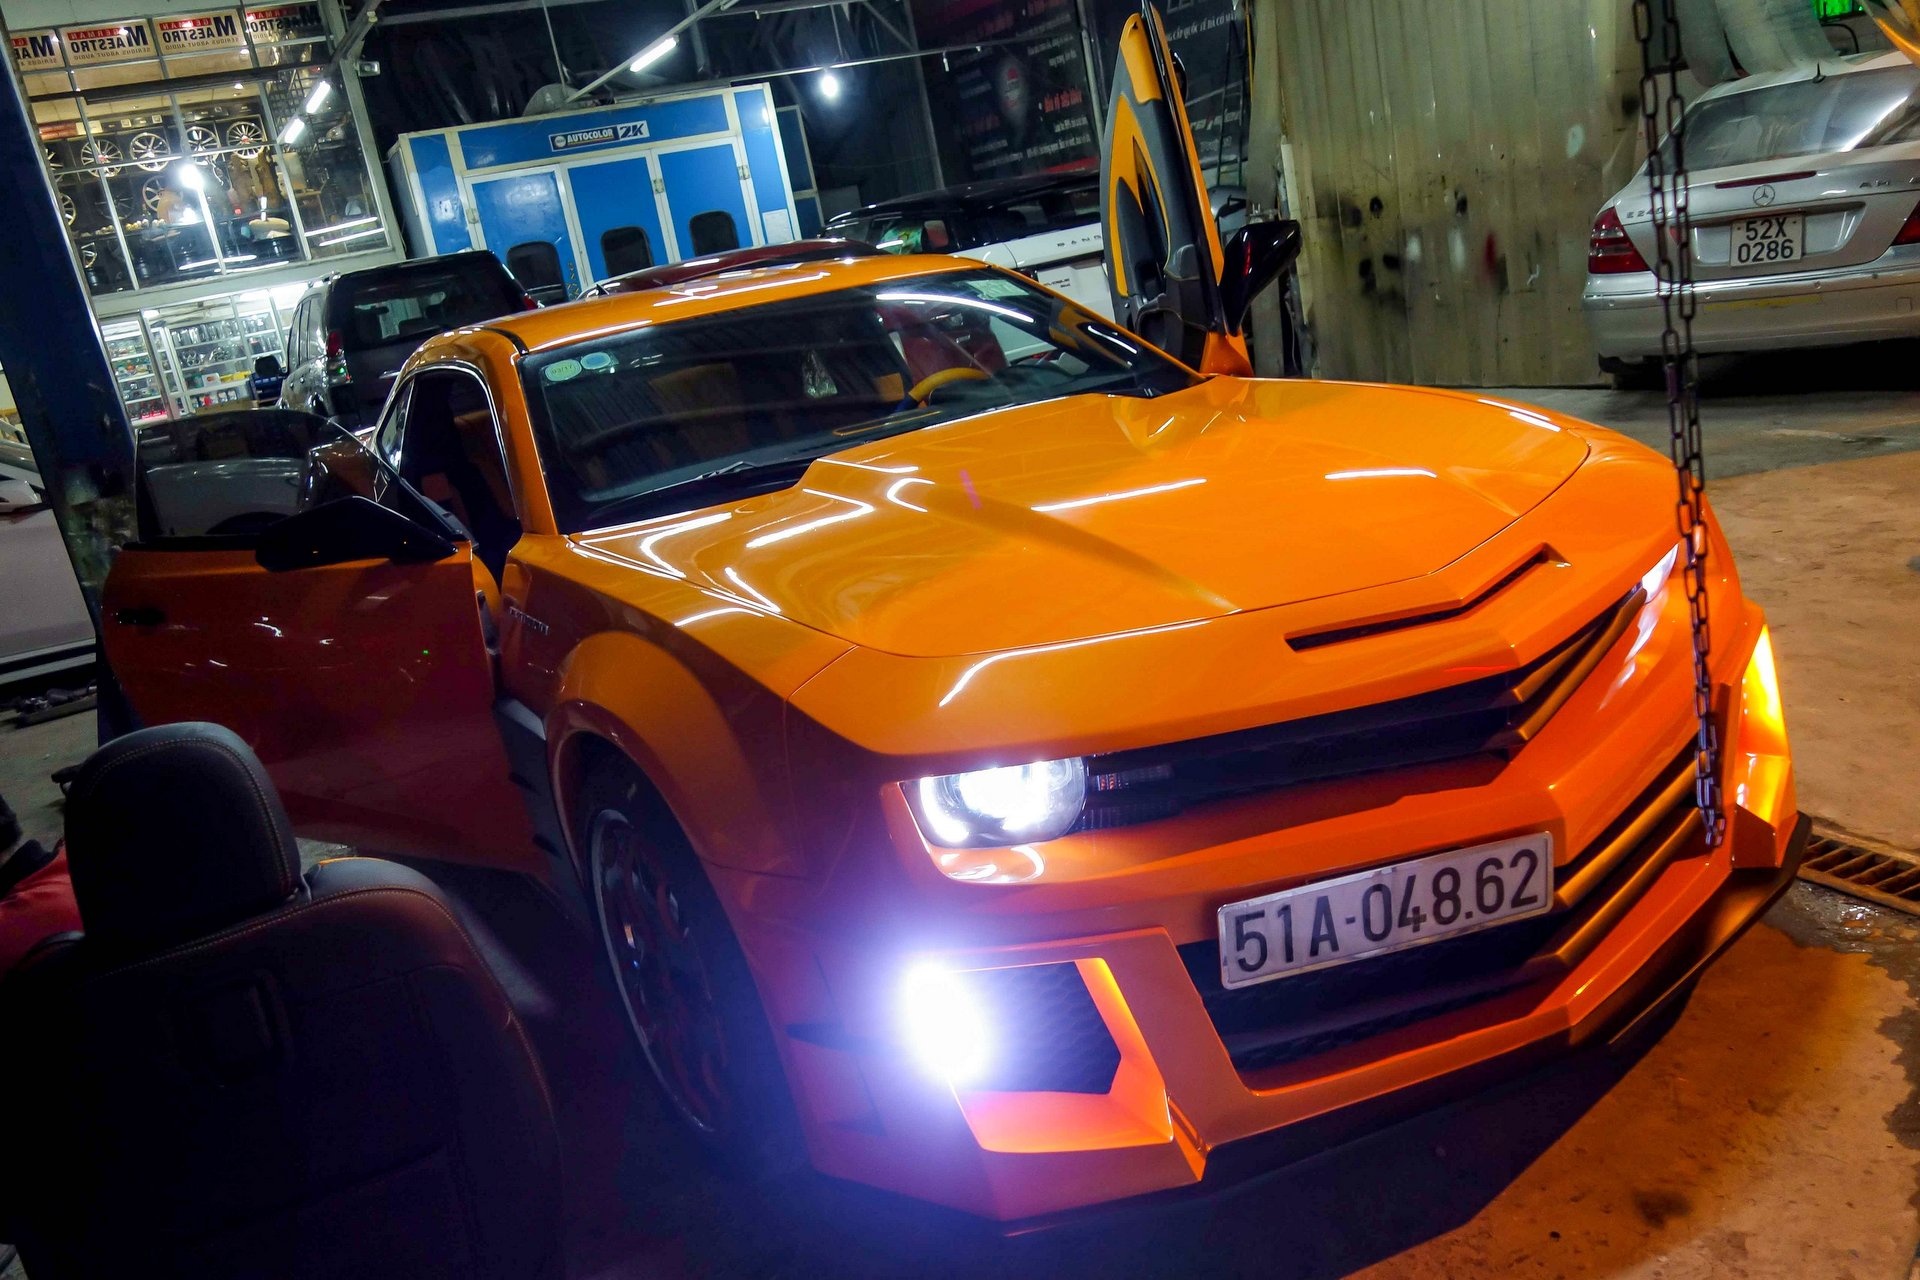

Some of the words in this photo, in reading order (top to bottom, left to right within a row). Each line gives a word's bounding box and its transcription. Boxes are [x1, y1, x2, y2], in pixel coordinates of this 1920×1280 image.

[567, 128, 613, 143] AUTOCOLOR
[619, 123, 644, 138] 2K
[1745, 216, 1788, 242] 52X
[1737, 239, 1794, 264] 0286
[1234, 848, 1539, 973] 51A-048.62
